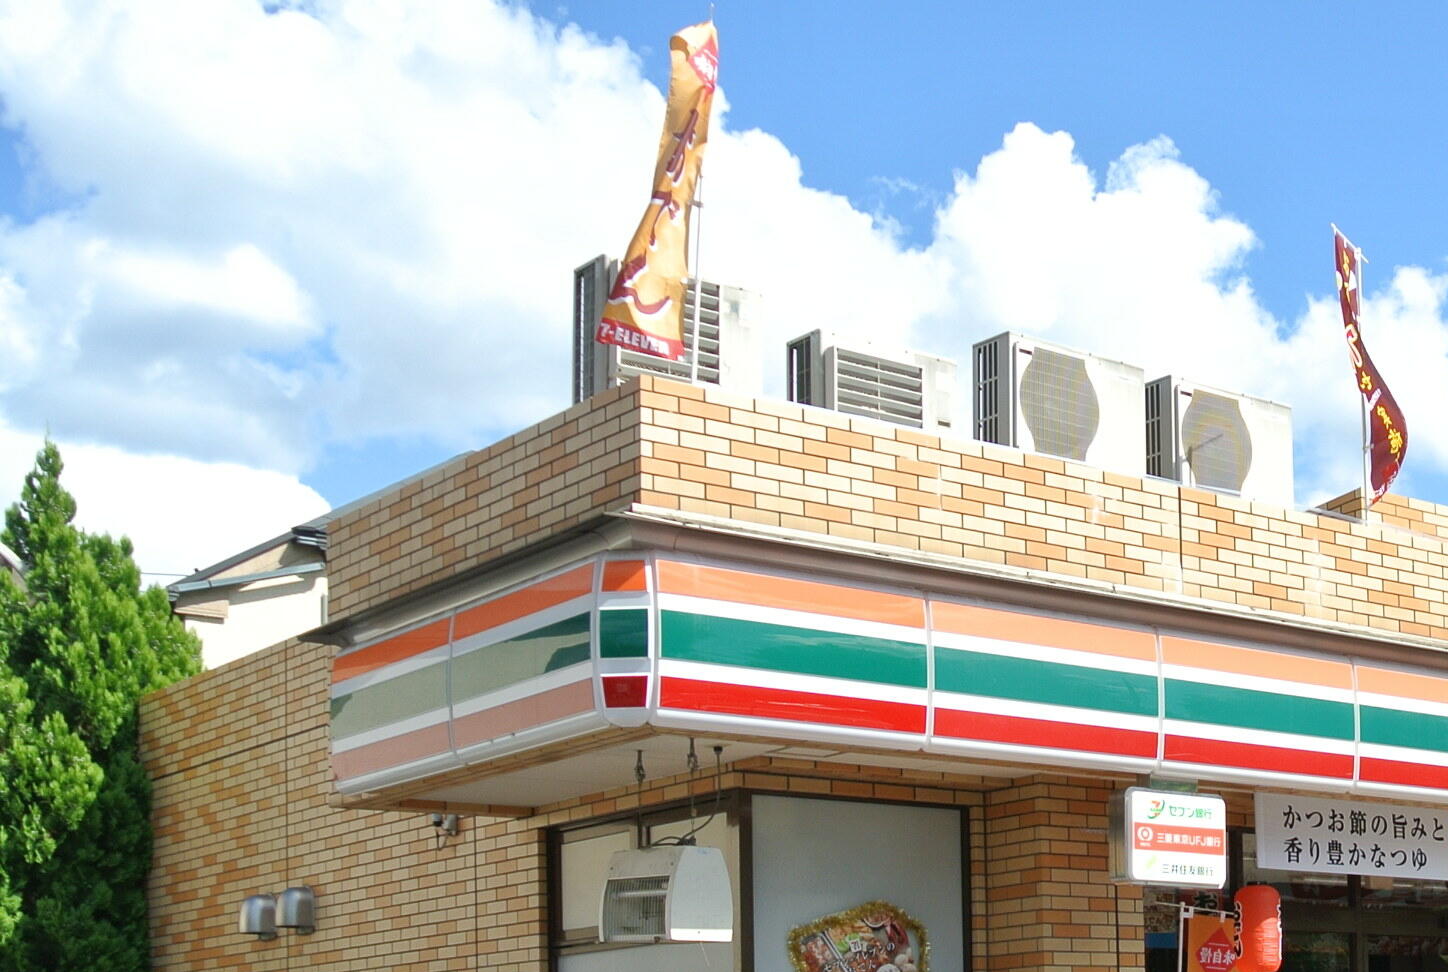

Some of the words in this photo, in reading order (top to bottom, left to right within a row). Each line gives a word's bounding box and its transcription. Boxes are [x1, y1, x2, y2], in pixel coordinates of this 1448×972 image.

[1157, 833, 1221, 847] 三菱東京UFJ銀行
[1282, 803, 1446, 843] かつお節の旨みと
[1284, 837, 1429, 871] 香り豊かなつゆ
